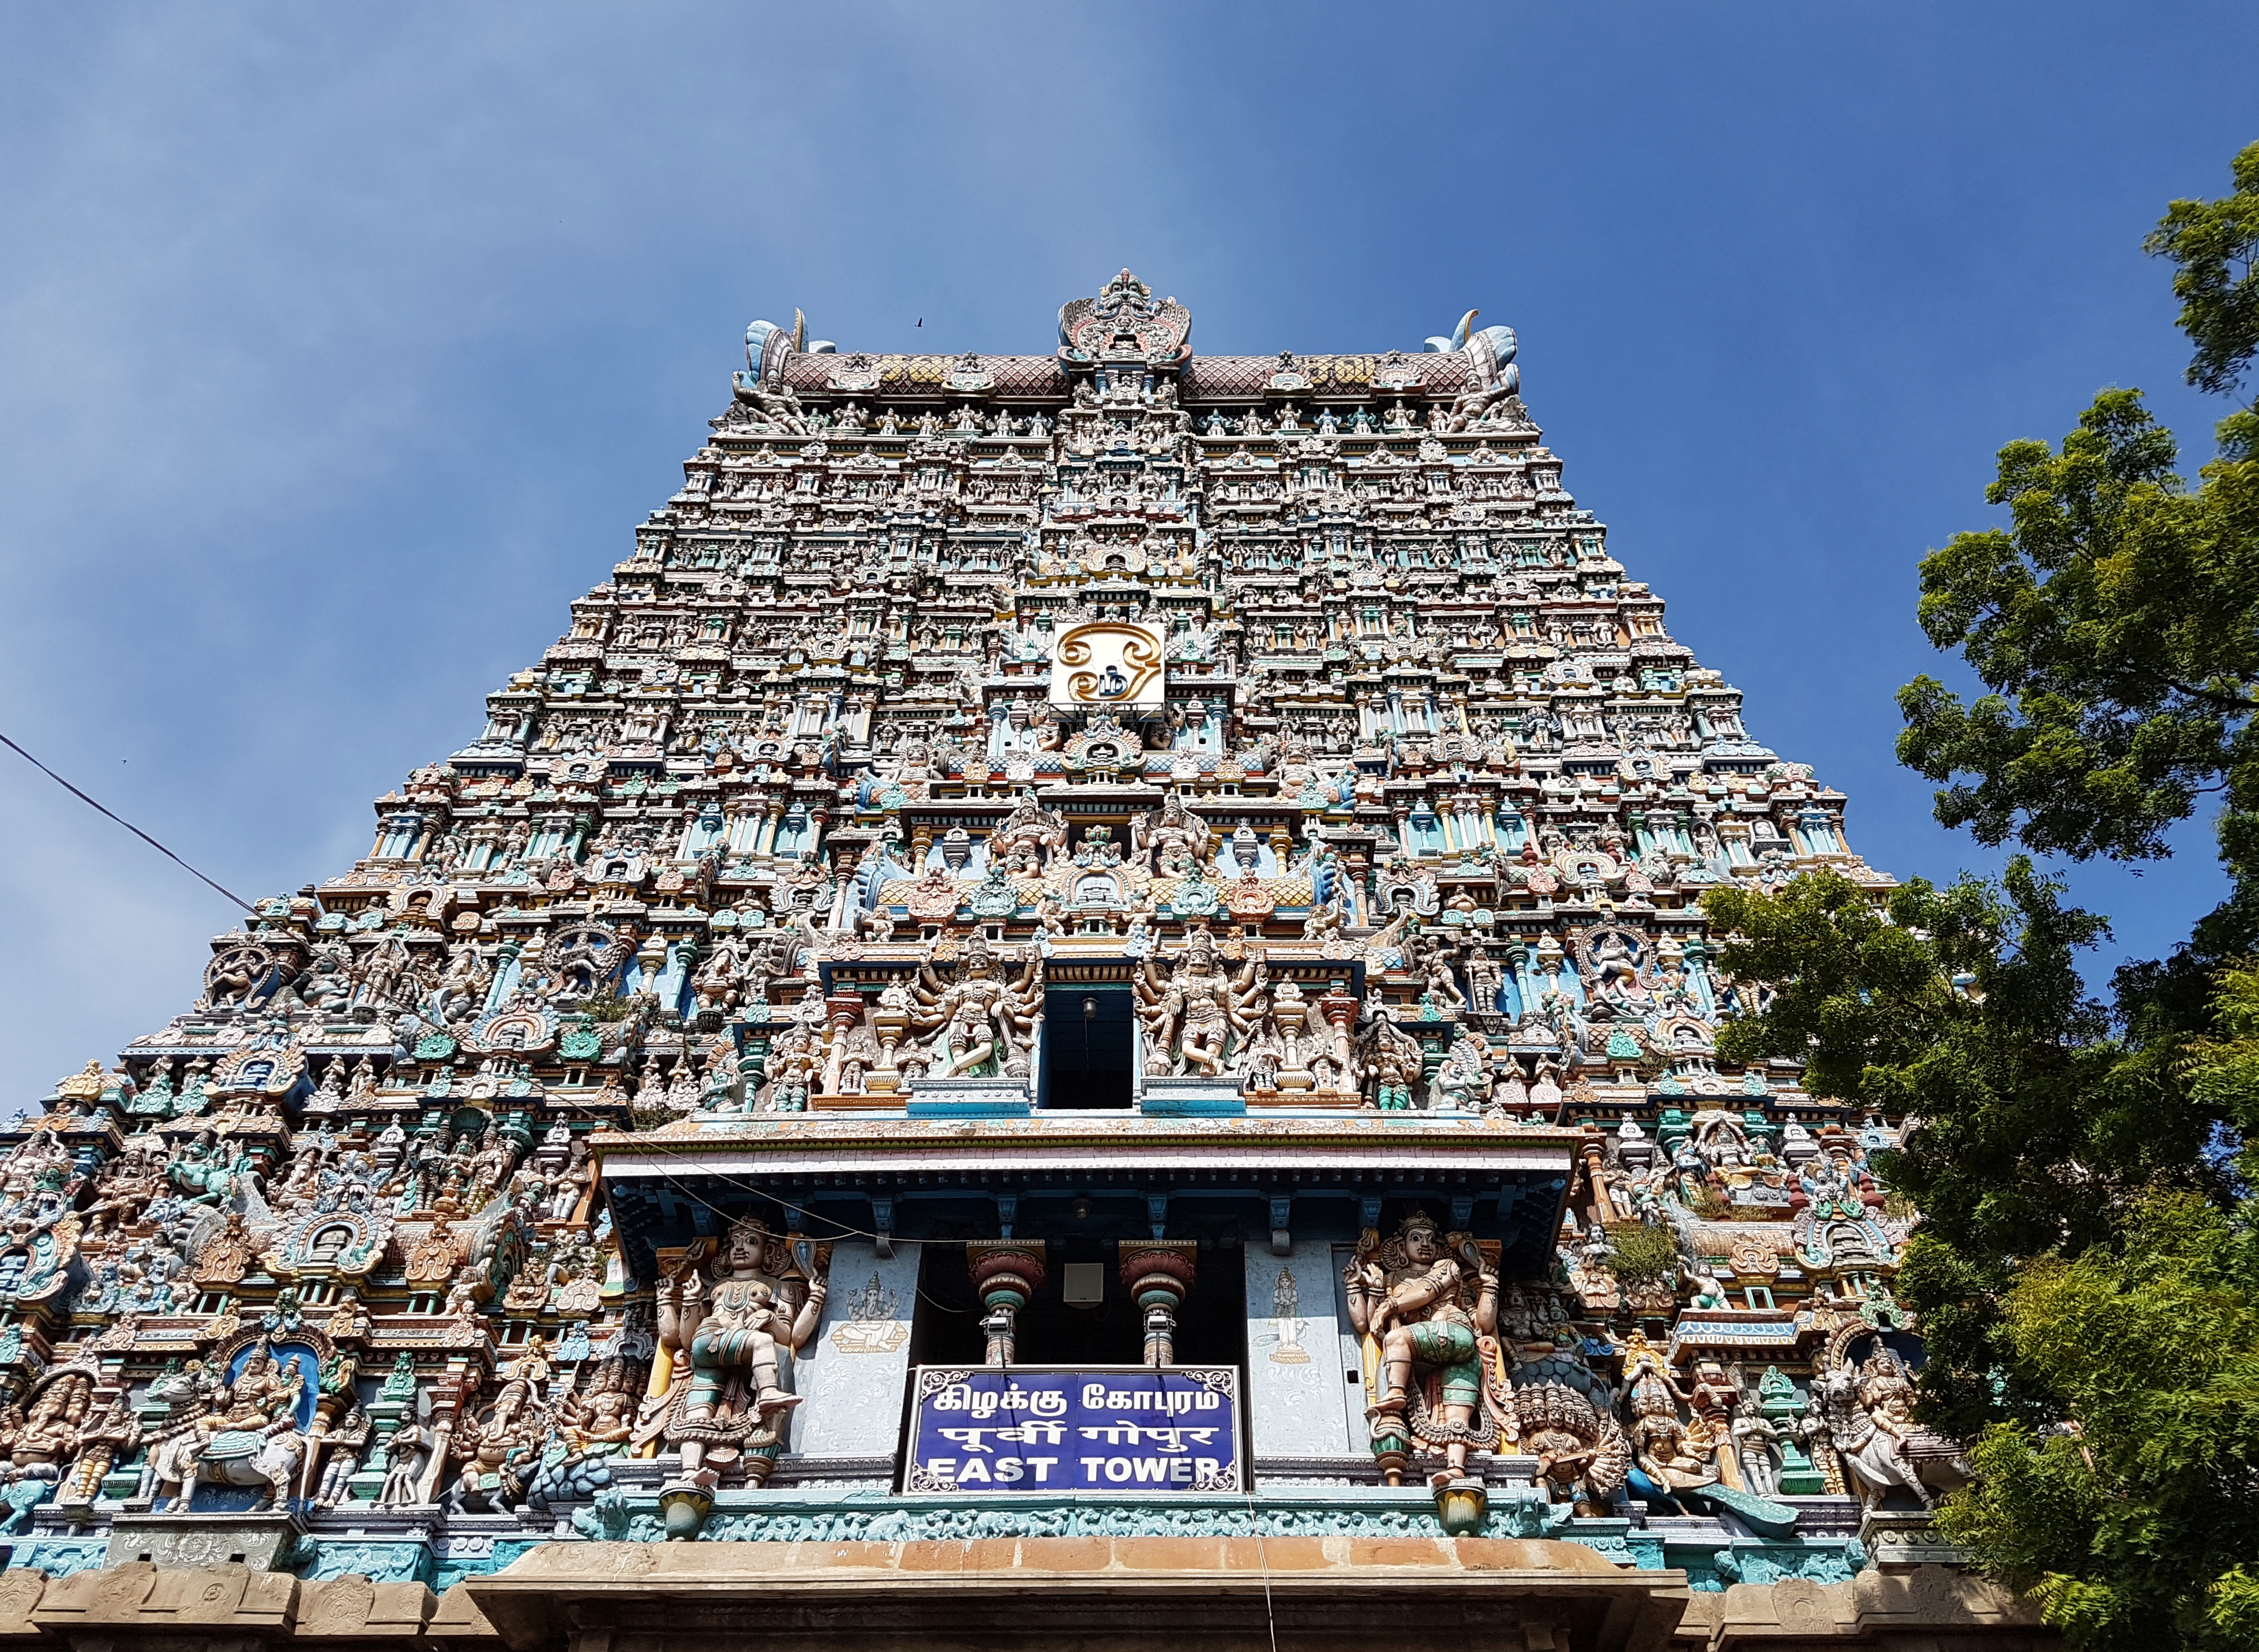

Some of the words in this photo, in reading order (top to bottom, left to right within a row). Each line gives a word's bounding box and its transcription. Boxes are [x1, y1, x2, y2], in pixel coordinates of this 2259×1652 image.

[933, 1383, 1067, 1419] கிழக்கு
[1082, 1383, 1219, 1417] கோபுரம்
[937, 1420, 1068, 1454] पूर्वी
[1078, 1420, 1219, 1453] गोपुर
[926, 1457, 1059, 1482] EAST
[1080, 1457, 1219, 1482] TOWER
